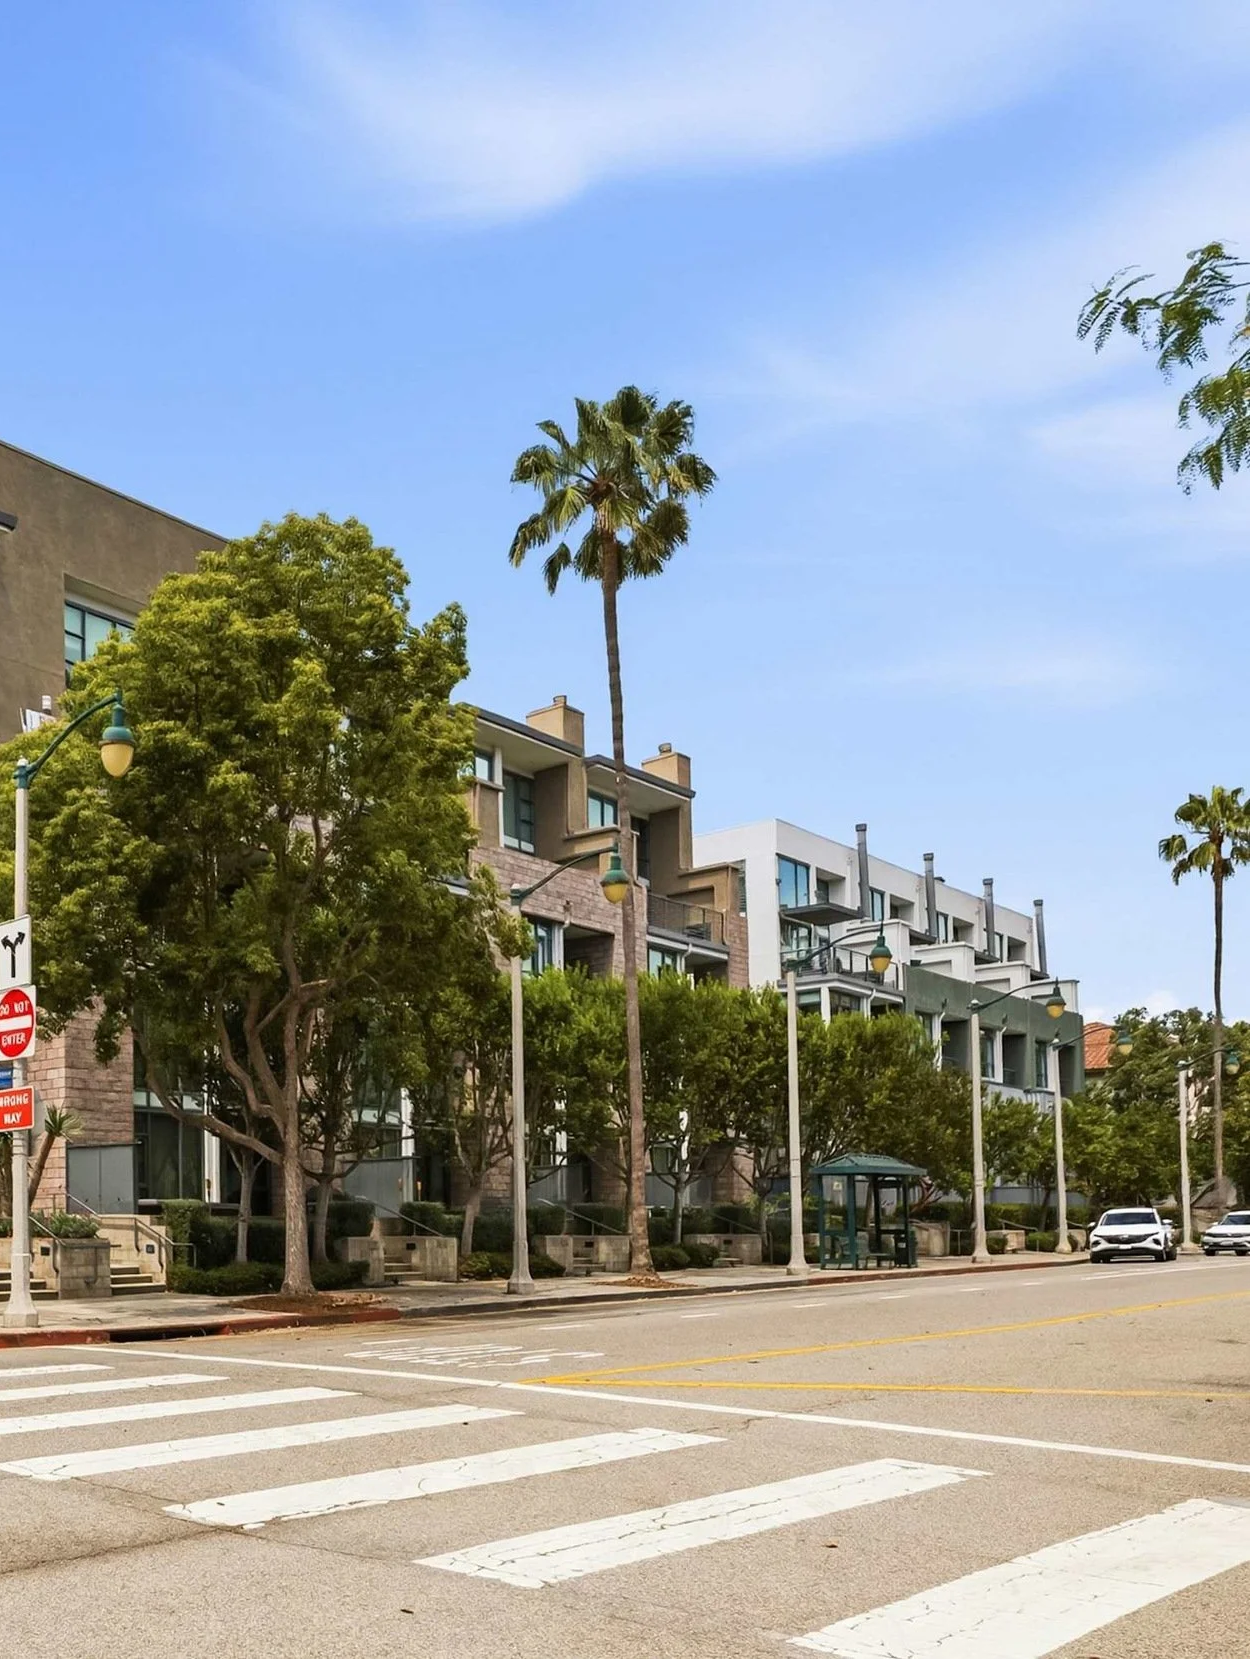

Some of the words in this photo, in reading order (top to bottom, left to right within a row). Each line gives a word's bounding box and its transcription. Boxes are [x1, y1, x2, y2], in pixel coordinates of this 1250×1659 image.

[0, 1004, 9, 1016] DO
[14, 1000, 30, 1013] NOT
[2, 1033, 25, 1047] ENTER
[3, 1111, 22, 1125] WAY
